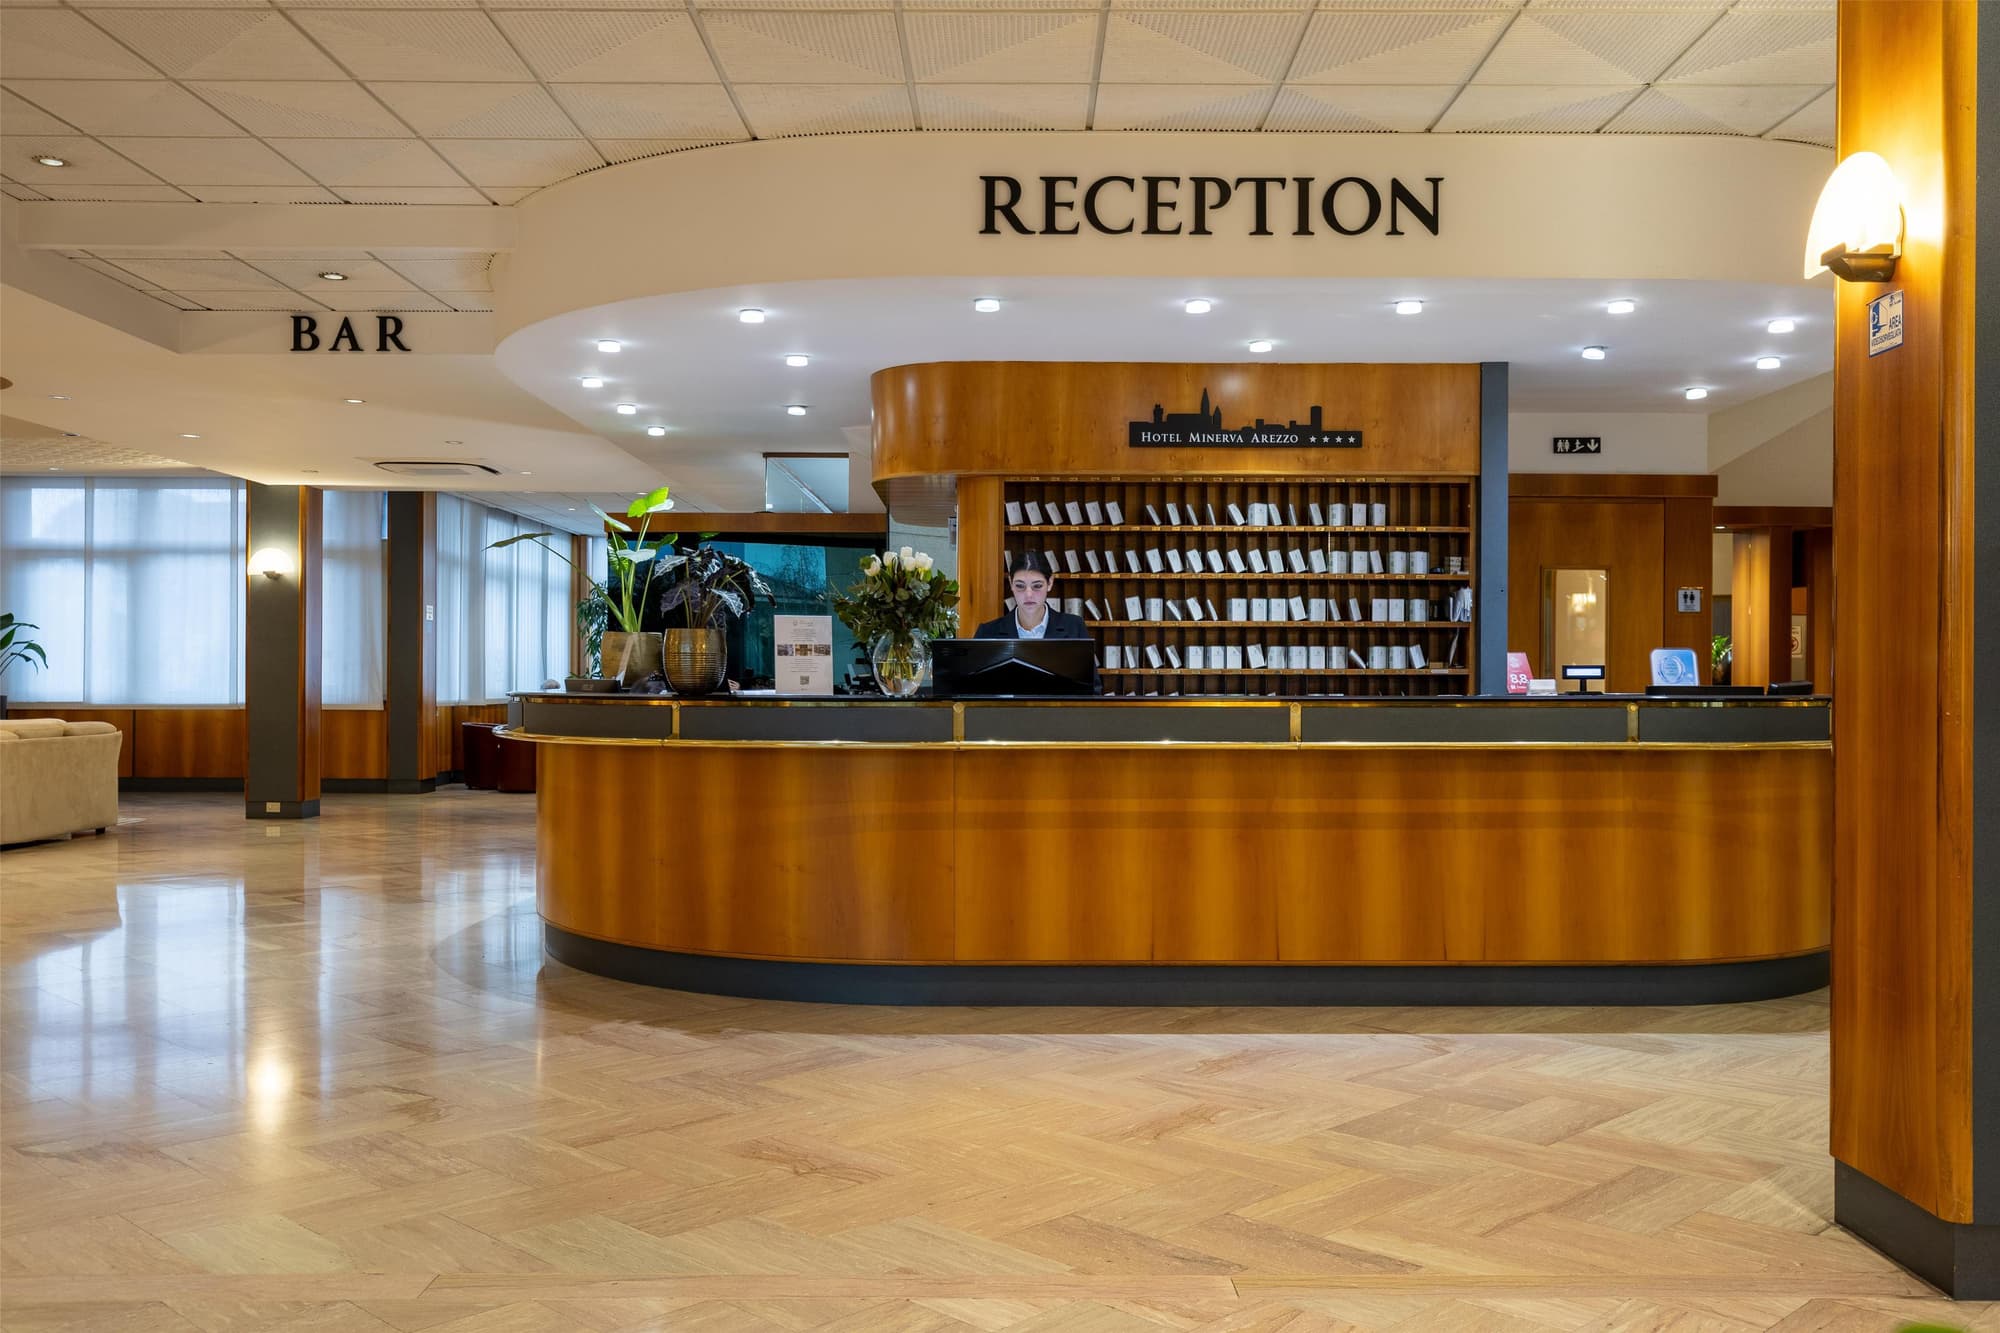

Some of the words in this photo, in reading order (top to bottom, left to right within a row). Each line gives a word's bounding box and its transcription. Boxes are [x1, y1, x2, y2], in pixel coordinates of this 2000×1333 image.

[978, 175, 1445, 236] RECEPTION
[289, 315, 412, 352] BAR
[1888, 314, 1902, 330] AREA
[1141, 431, 1182, 443] HOTEL
[1188, 431, 1244, 443] MINERVA
[1250, 432, 1299, 444] AREZZO
